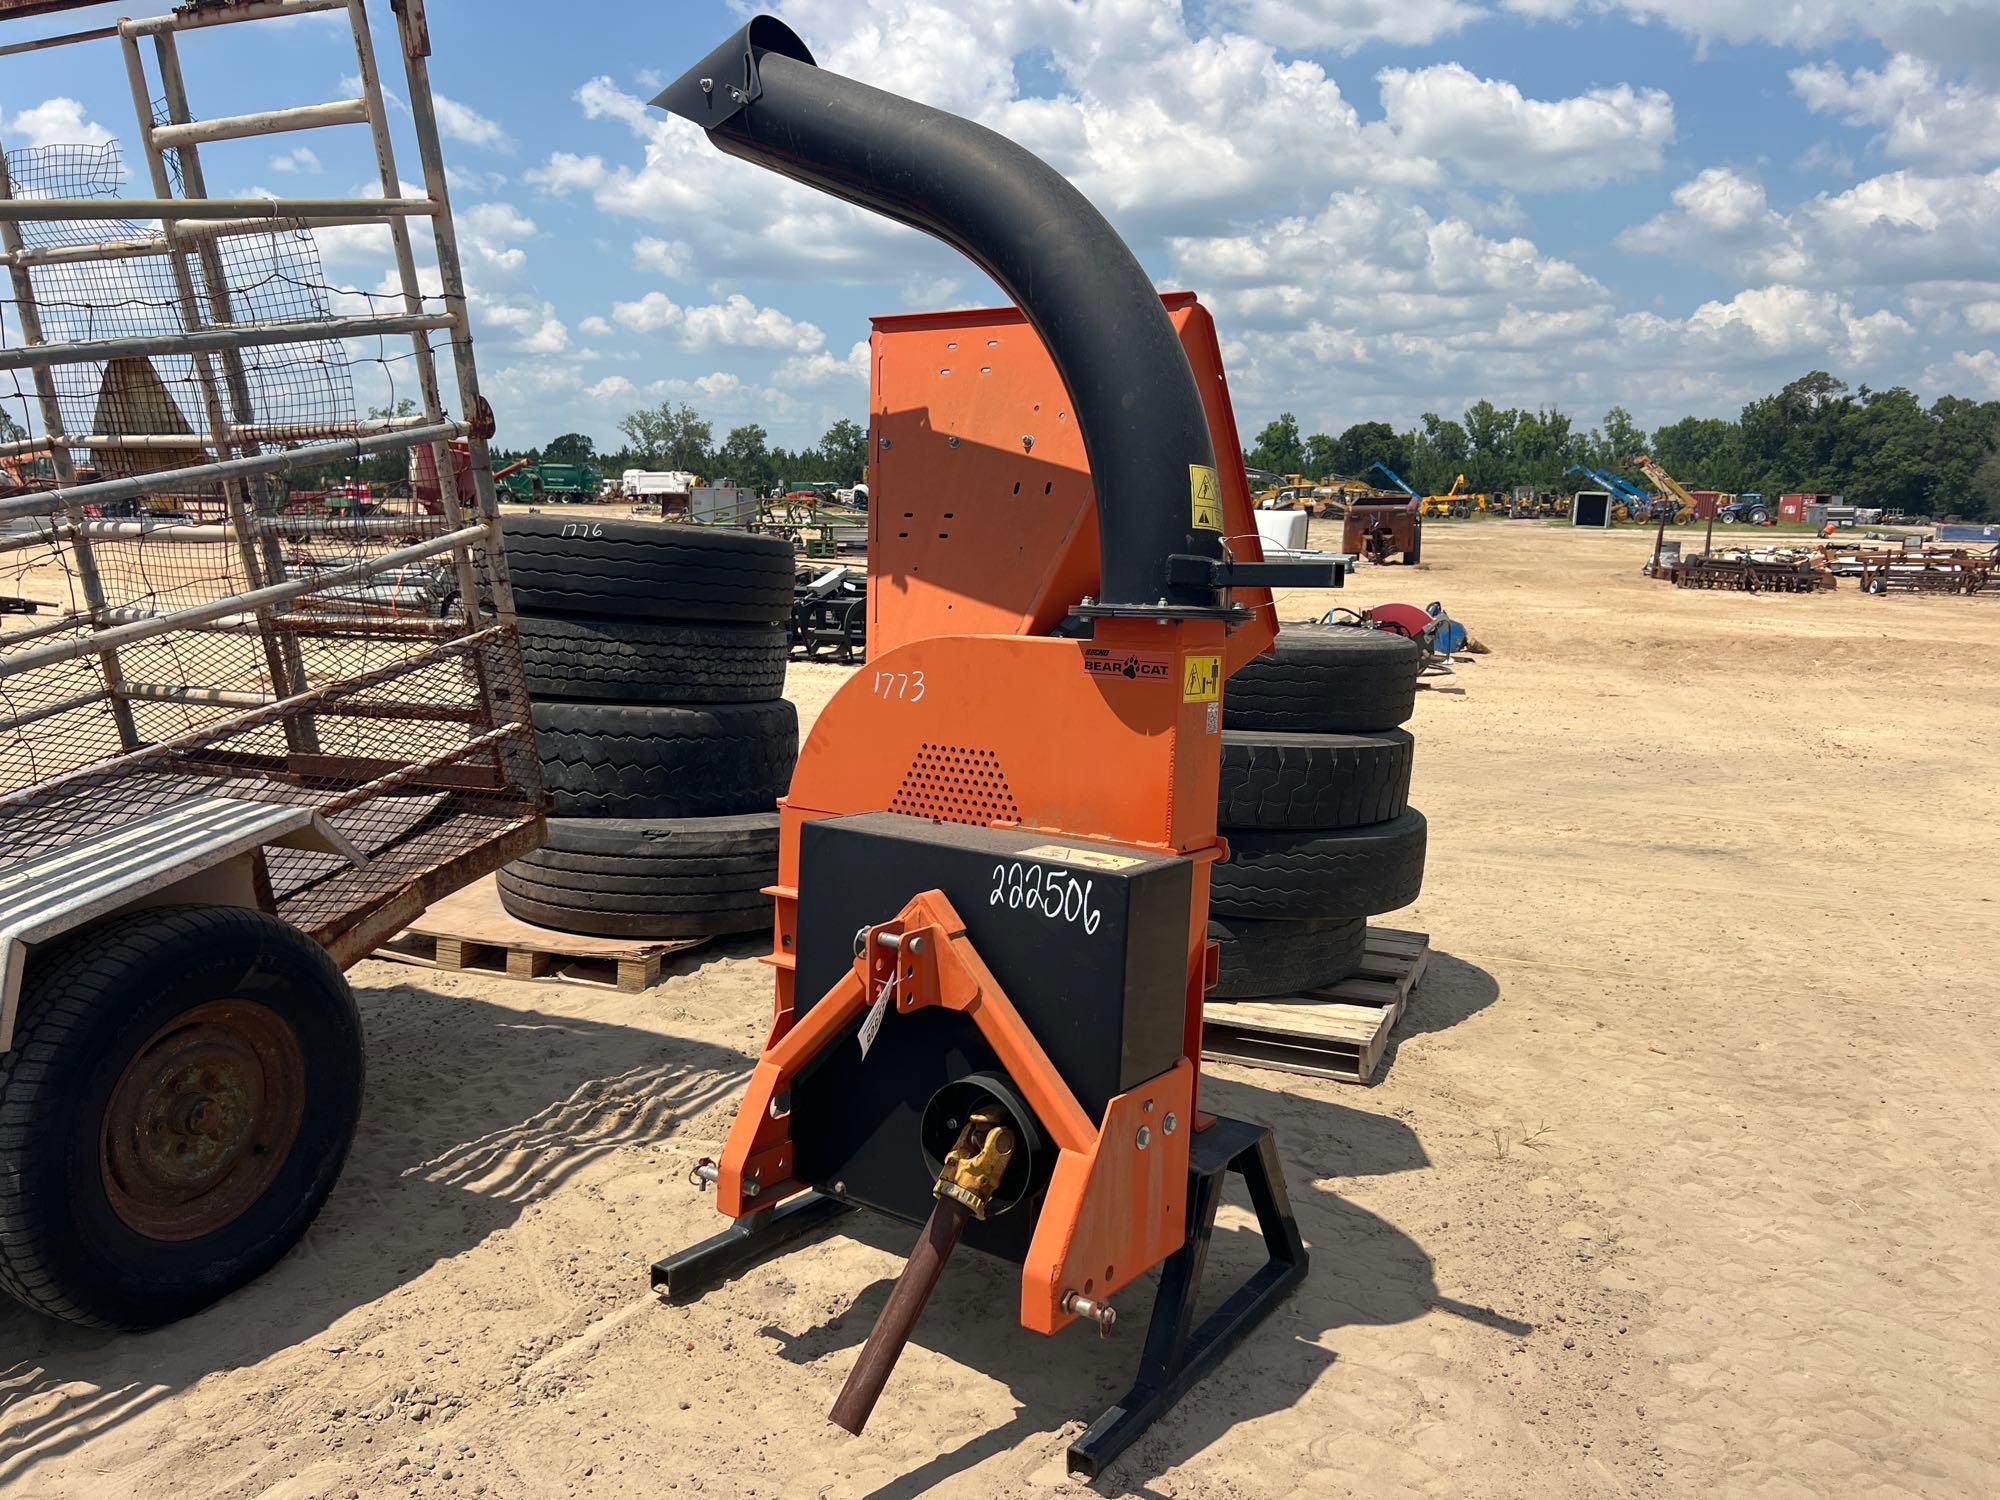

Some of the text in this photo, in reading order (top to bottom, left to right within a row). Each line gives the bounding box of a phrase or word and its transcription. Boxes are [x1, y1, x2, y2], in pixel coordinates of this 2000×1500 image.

[561, 523, 603, 538] 1776
[1085, 661, 1169, 675] BEAR CAT
[874, 670, 925, 702] 1773
[989, 862, 1101, 936] 222506
